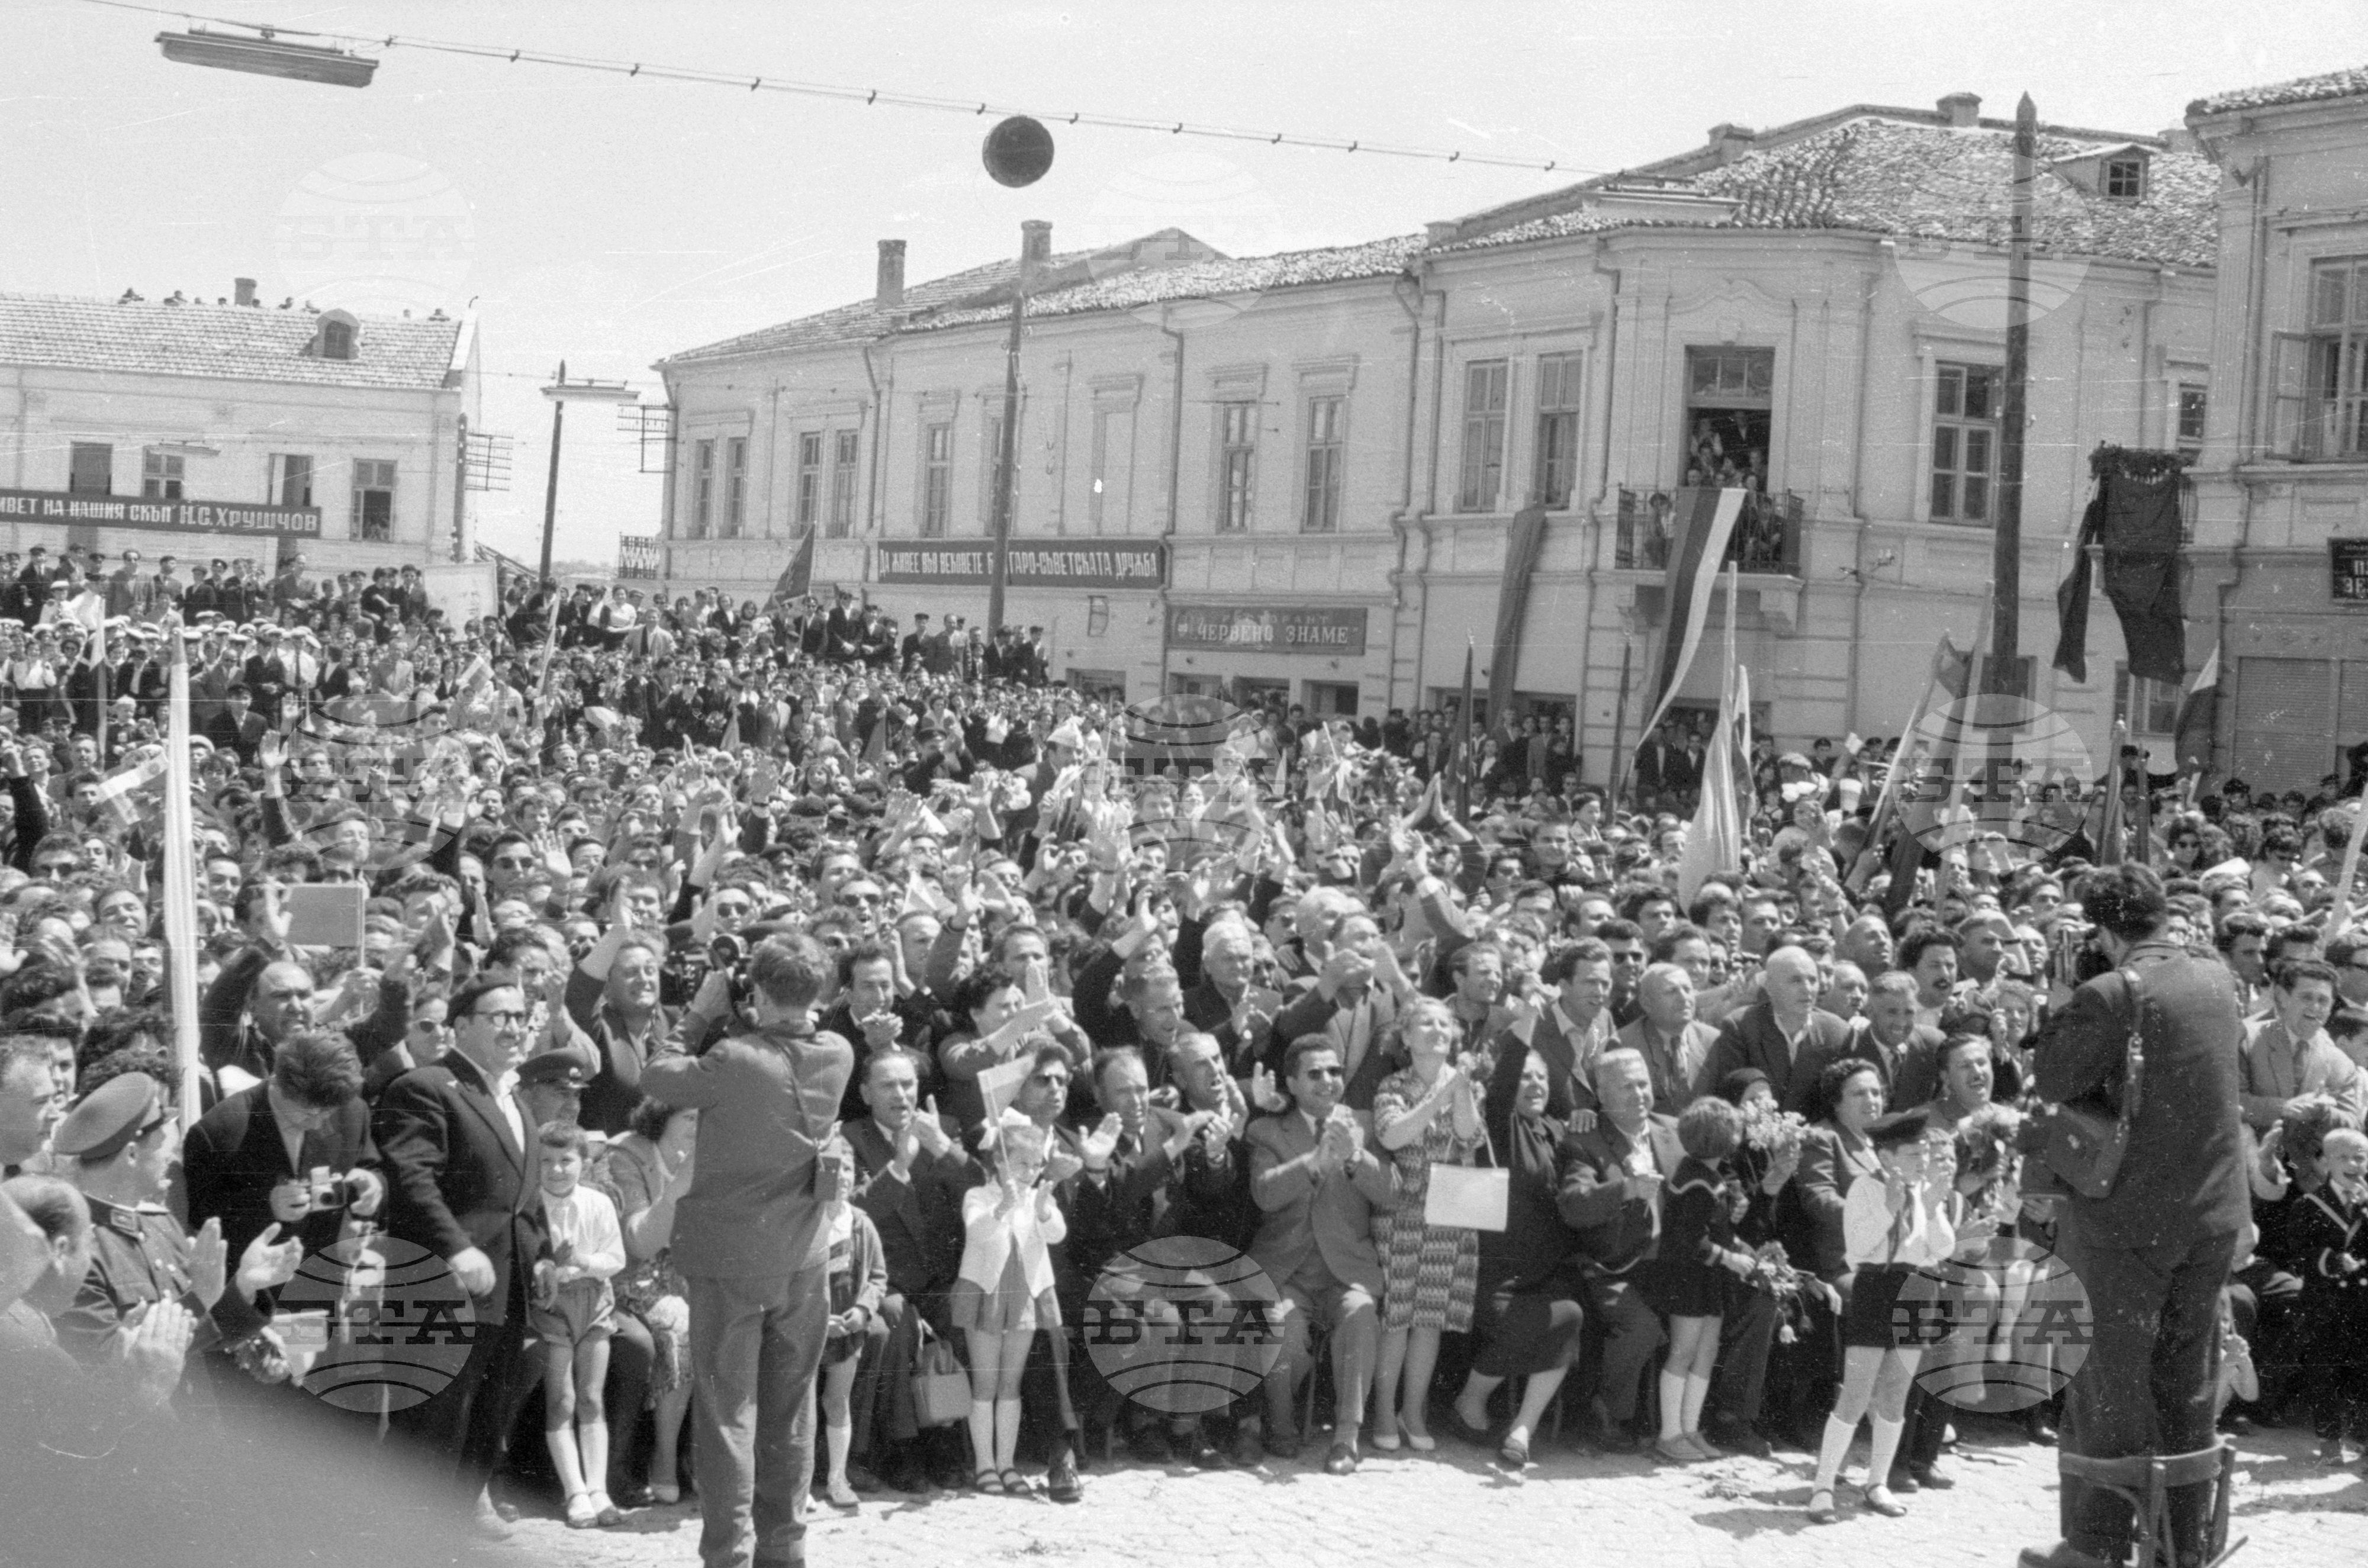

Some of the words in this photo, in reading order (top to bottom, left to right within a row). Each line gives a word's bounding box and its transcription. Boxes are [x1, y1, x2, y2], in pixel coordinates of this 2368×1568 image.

[44, 499, 64, 516] НА
[70, 501, 124, 520] НАШИЯ
[879, 549, 890, 578] ДА
[892, 552, 919, 574] ЖИВЕЕ
[922, 552, 938, 574] ВЪВ
[940, 552, 983, 575] ВЕКОВЕТЕ
[1115, 552, 1157, 581] ДРУЖБА
[2354, 561, 2368, 575] П
[2343, 577, 2368, 593] ЗЕ
